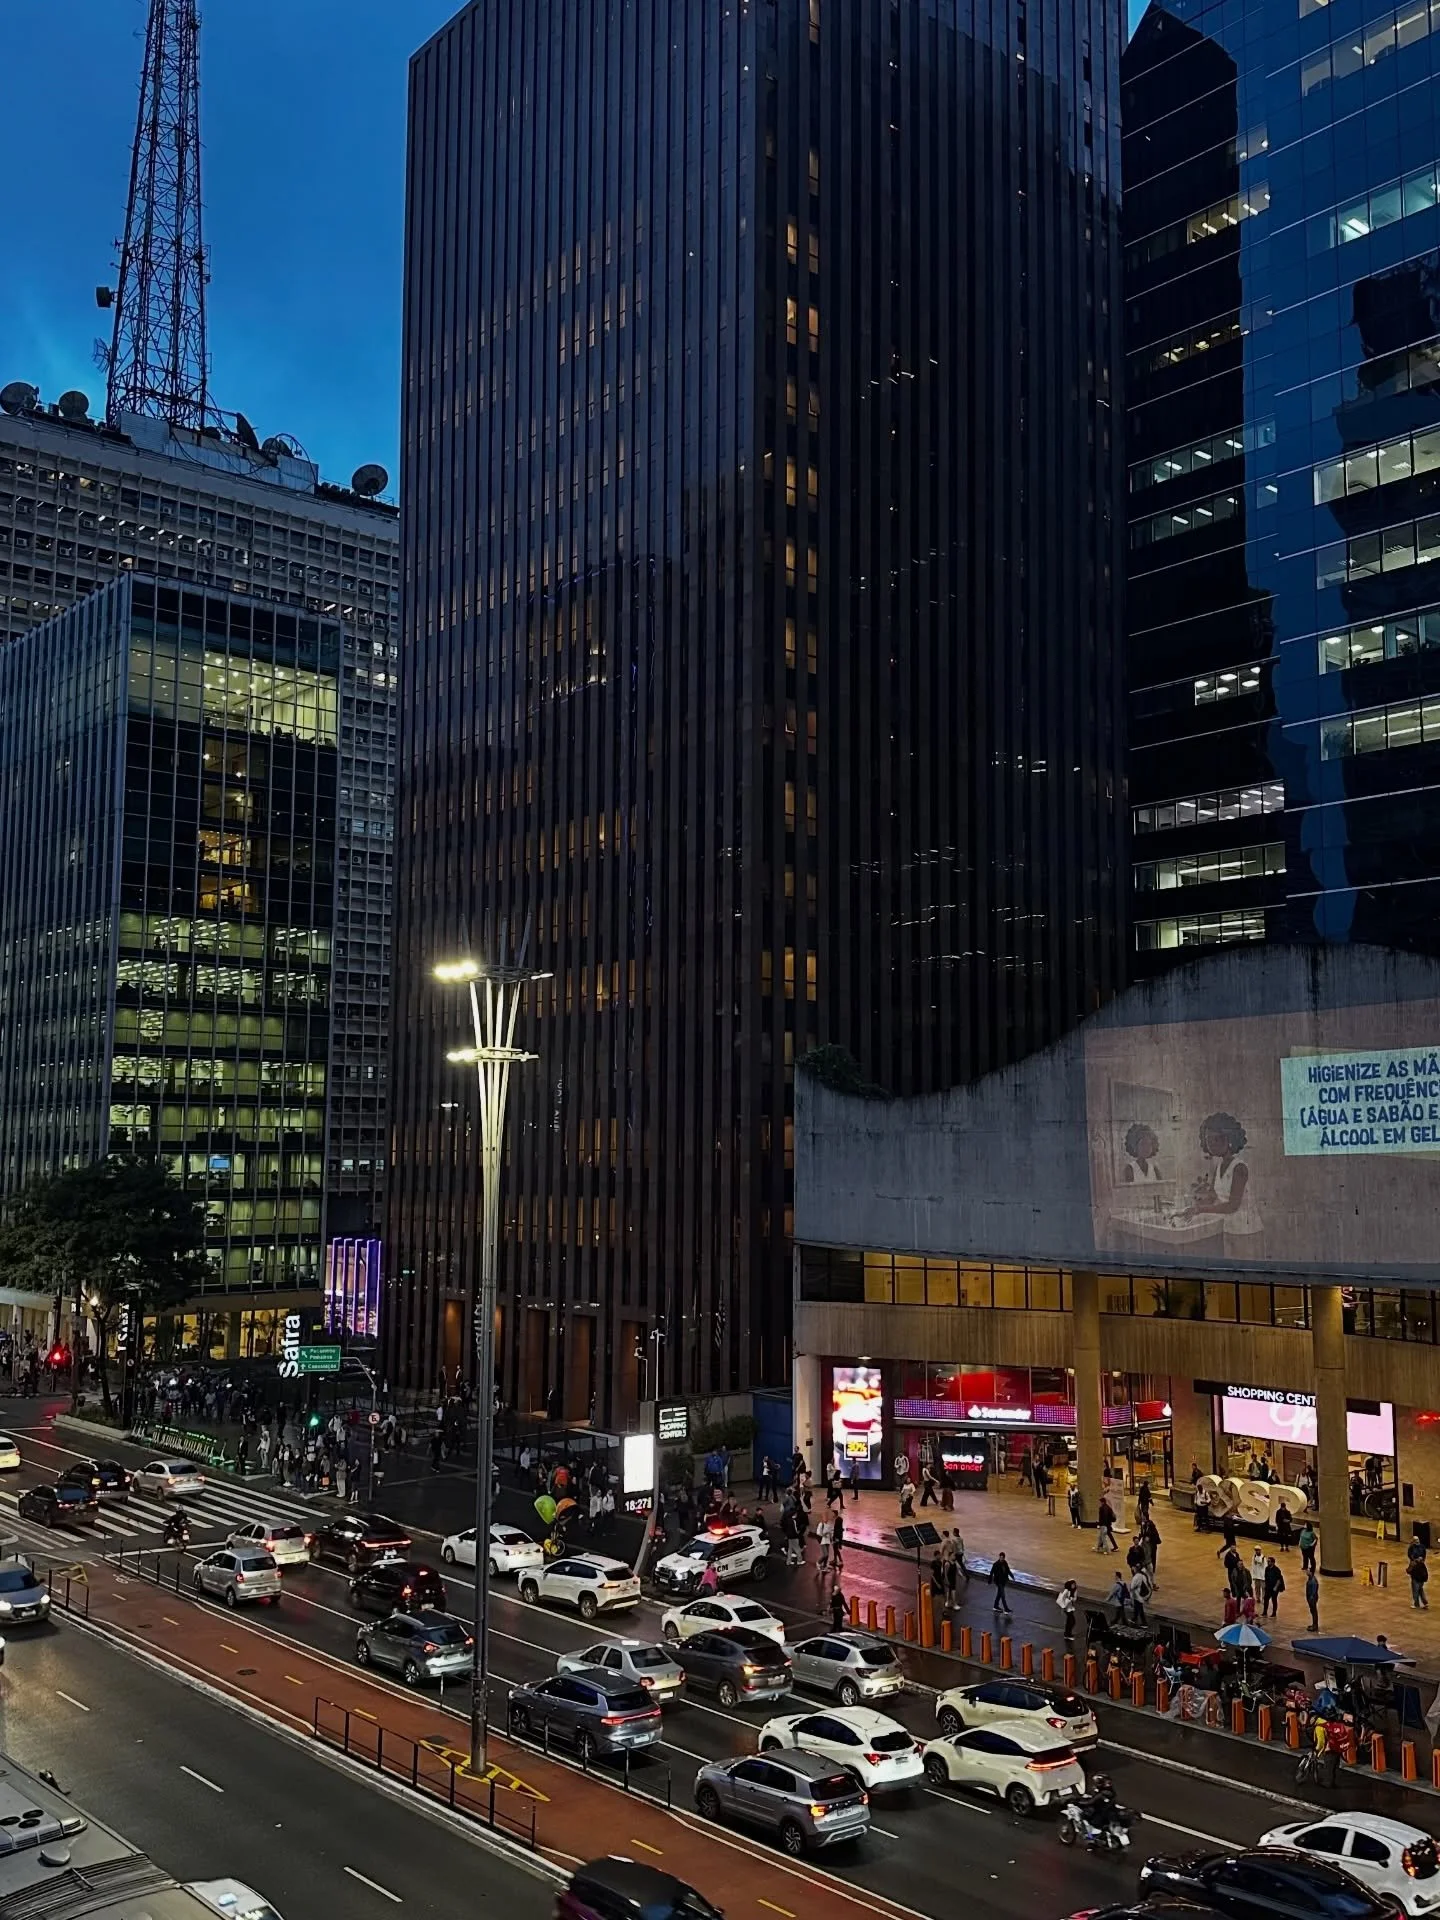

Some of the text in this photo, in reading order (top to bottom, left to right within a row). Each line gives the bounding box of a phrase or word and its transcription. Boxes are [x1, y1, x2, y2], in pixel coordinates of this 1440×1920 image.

[1386, 1060, 1409, 1078] AS
[1319, 1077, 1440, 1104] COM FREQUÊNC
[1353, 1108, 1362, 1123] E
[1367, 1100, 1424, 1123] SABÃO
[1320, 1125, 1440, 1147] ÁLCOOL EM GEL
[278, 1314, 300, 1379] Safra
[1227, 1386, 1284, 1402] SHOPPING
